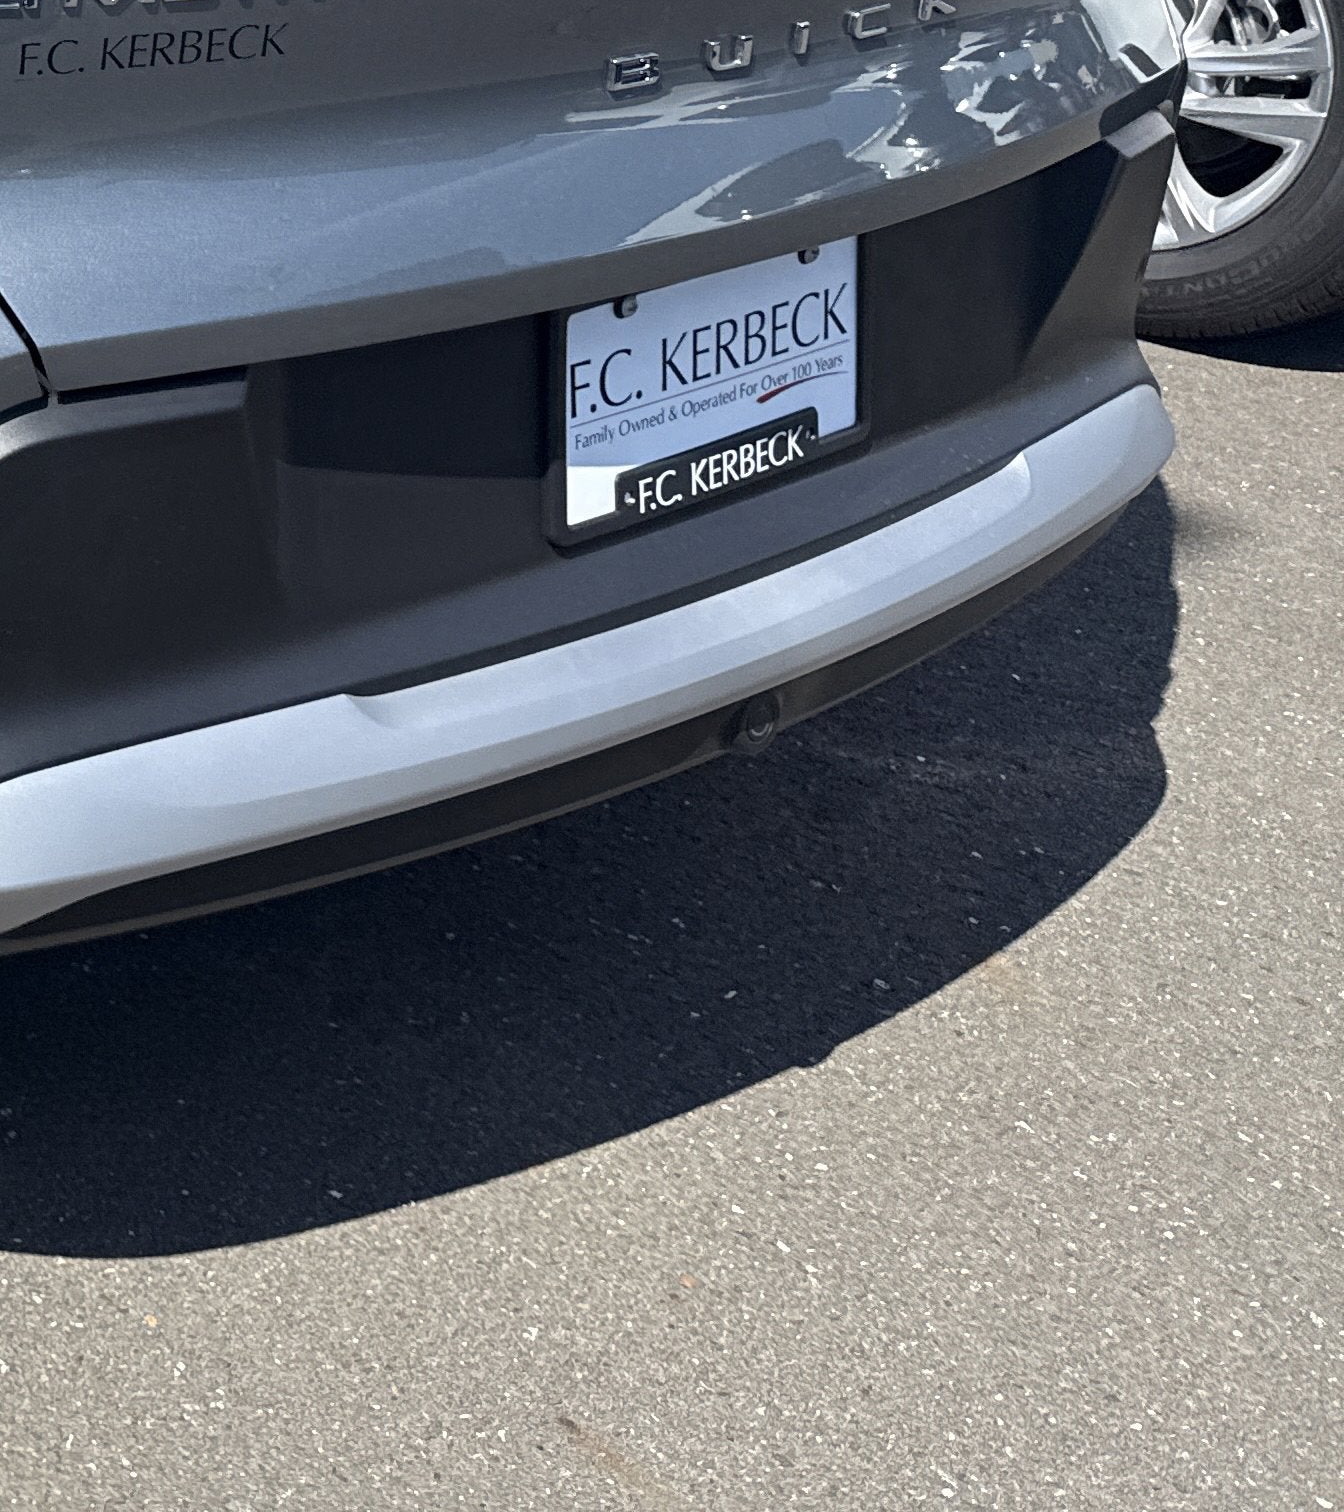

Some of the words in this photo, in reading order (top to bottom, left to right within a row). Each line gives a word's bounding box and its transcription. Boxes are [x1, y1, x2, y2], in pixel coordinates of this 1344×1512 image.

[18, 39, 84, 77] F.C.
[99, 22, 291, 72] KERBECK
[569, 348, 643, 419] F.C.
[661, 282, 848, 392] KERBECK
[574, 424, 615, 451] Family
[618, 408, 665, 437] Owned
[667, 402, 678, 422] &
[681, 389, 737, 418] Operated
[739, 381, 759, 402] For
[761, 371, 789, 392] Over
[792, 361, 813, 382] 100
[815, 353, 844, 376] Years
[638, 469, 683, 514] F.C.
[690, 424, 804, 496] KERBECK
